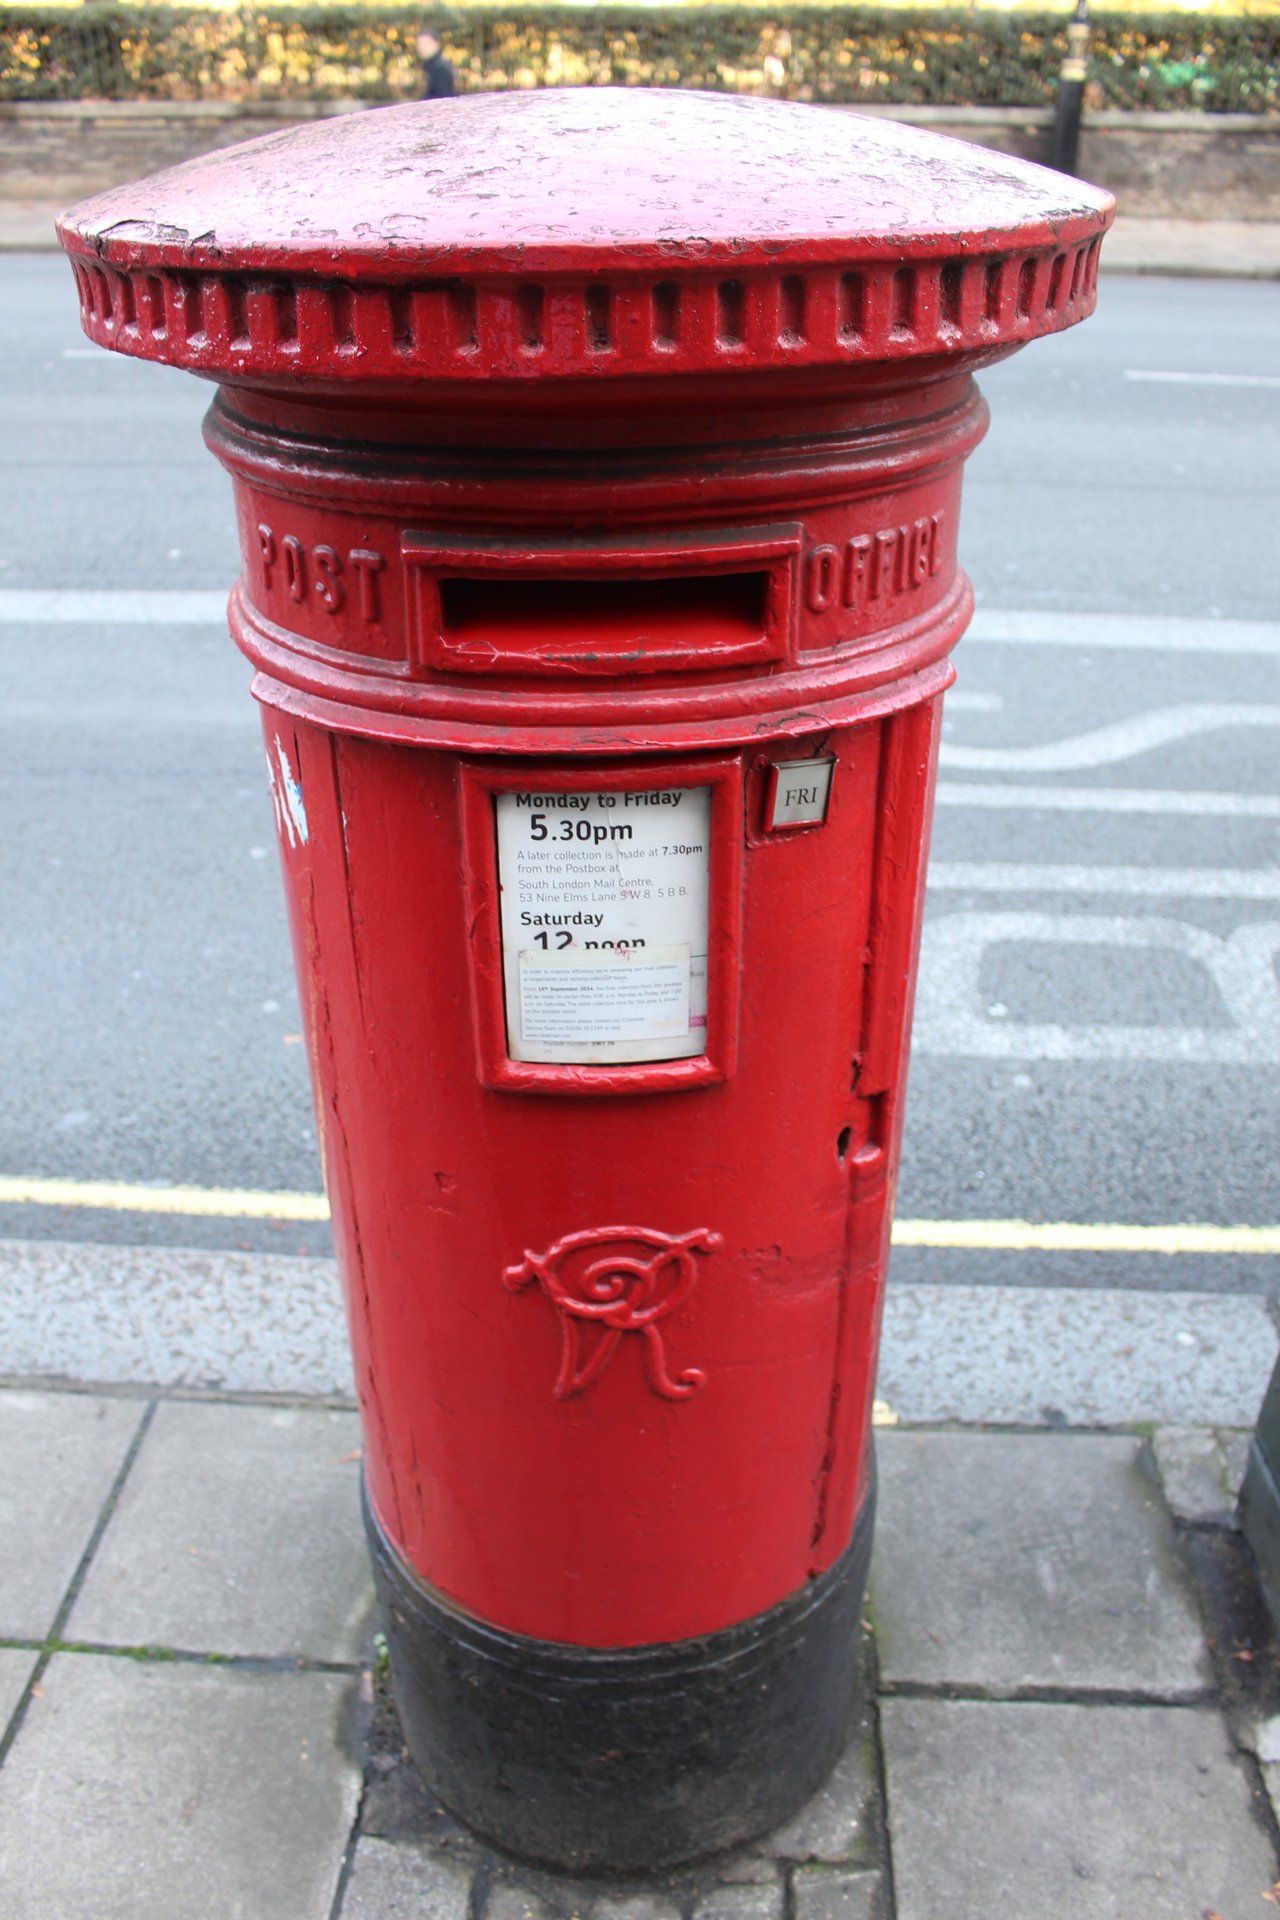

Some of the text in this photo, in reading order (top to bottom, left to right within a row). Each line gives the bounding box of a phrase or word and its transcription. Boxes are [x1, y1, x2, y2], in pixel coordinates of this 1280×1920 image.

[807, 509, 945, 613] OFFICE
[257, 523, 386, 623] POST
[516, 791, 682, 811] Monday to Friday
[785, 786, 818, 807] FRI
[530, 813, 633, 845] 5.30pm
[517, 844, 703, 860] A later collection is made at 7.30pm
[518, 864, 620, 874] from the Postbox at
[518, 880, 549, 889] South
[552, 880, 591, 889] London
[594, 879, 615, 888] Mail
[520, 893, 533, 902] 53
[536, 892, 560, 902] Nine
[563, 892, 588, 902] Elms
[592, 891, 617, 901] Lane
[520, 911, 604, 928] Saturday
[533, 930, 646, 950] 12 noon
